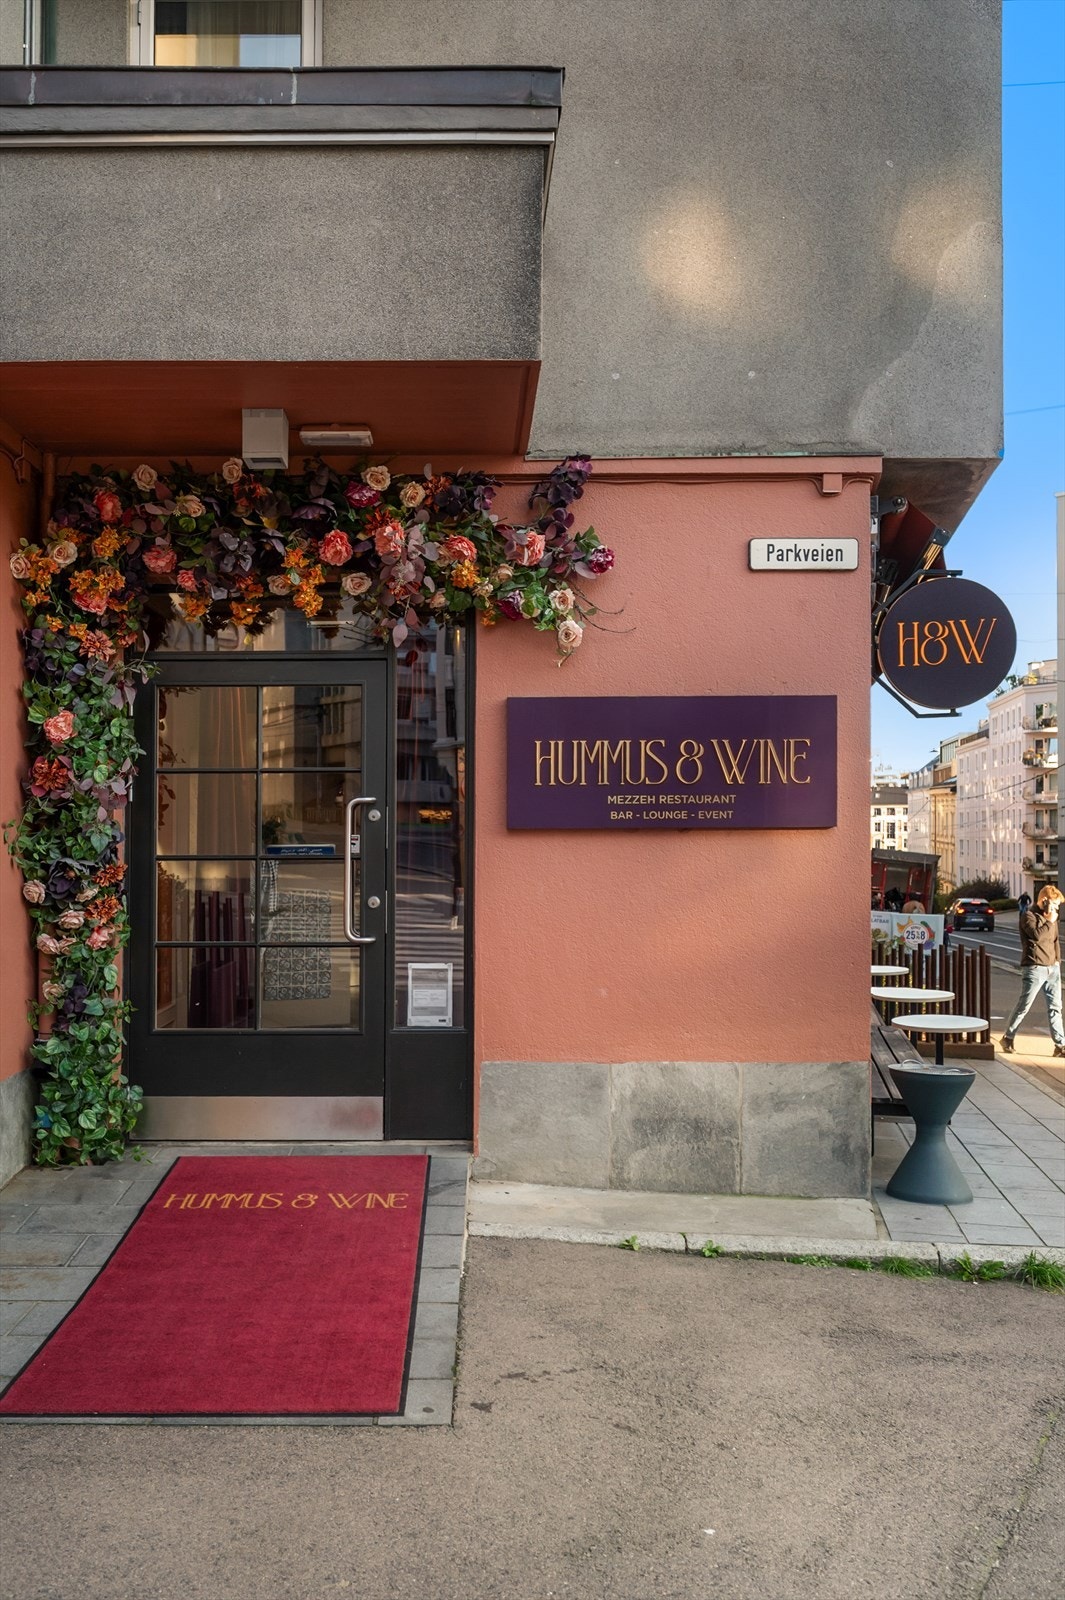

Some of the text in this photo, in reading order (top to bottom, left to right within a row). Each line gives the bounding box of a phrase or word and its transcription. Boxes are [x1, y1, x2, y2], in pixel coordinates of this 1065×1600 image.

[766, 543, 844, 562] Parkveien
[897, 618, 997, 667] H&W
[534, 738, 812, 786] HUMMUS & WINE
[607, 794, 737, 805] MEZZEH RESTAURANT
[610, 810, 633, 820] BAR
[643, 810, 688, 820] LOUNGE
[698, 810, 733, 819] EVENT
[163, 1192, 409, 1210] HUMMUS & WINE
